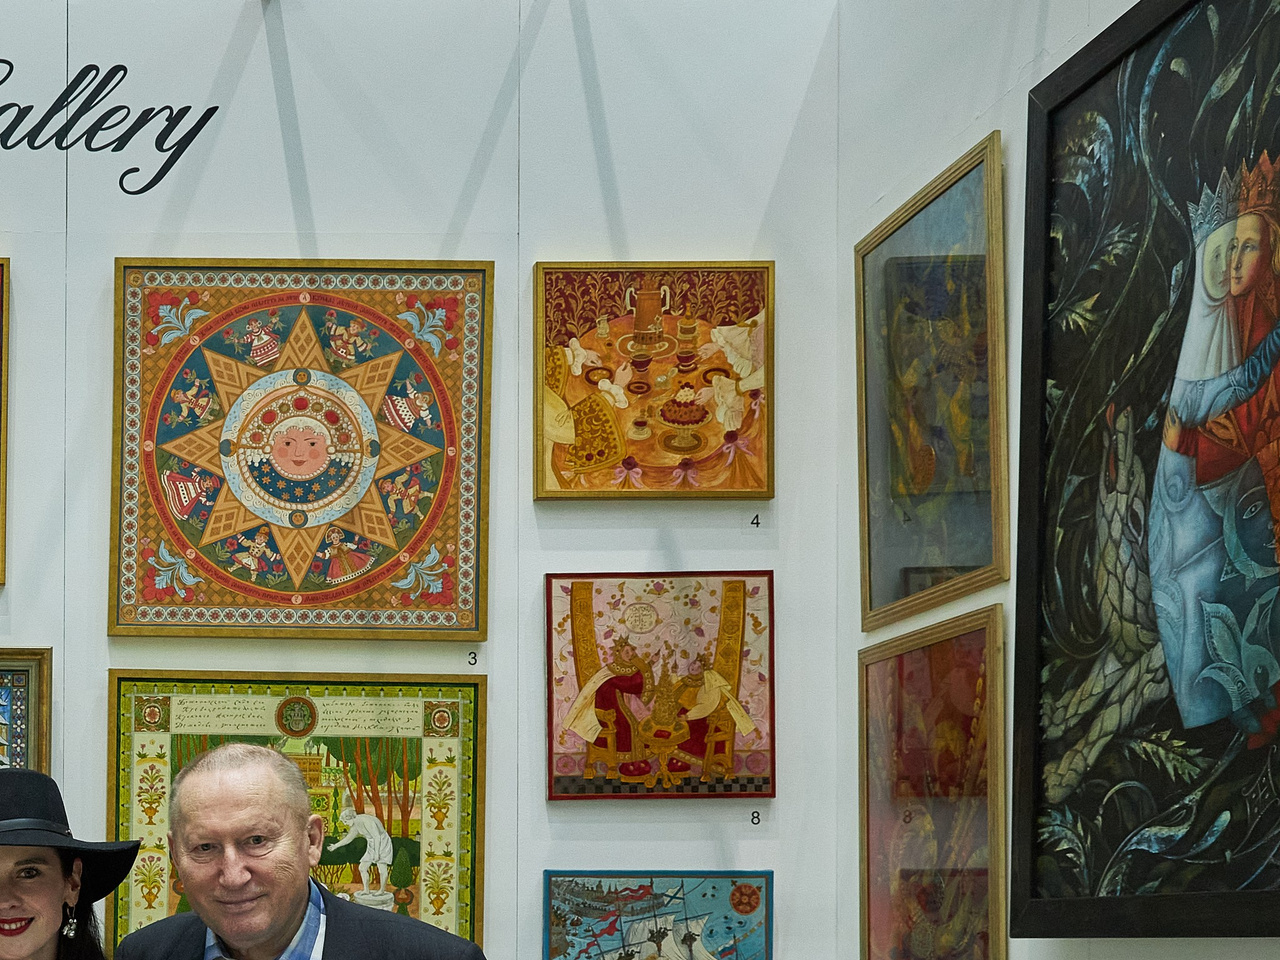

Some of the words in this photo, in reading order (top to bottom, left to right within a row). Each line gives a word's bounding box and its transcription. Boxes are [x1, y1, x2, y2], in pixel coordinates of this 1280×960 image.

[750, 513, 761, 529] 4
[467, 651, 478, 666] 3
[750, 810, 761, 826] 8
